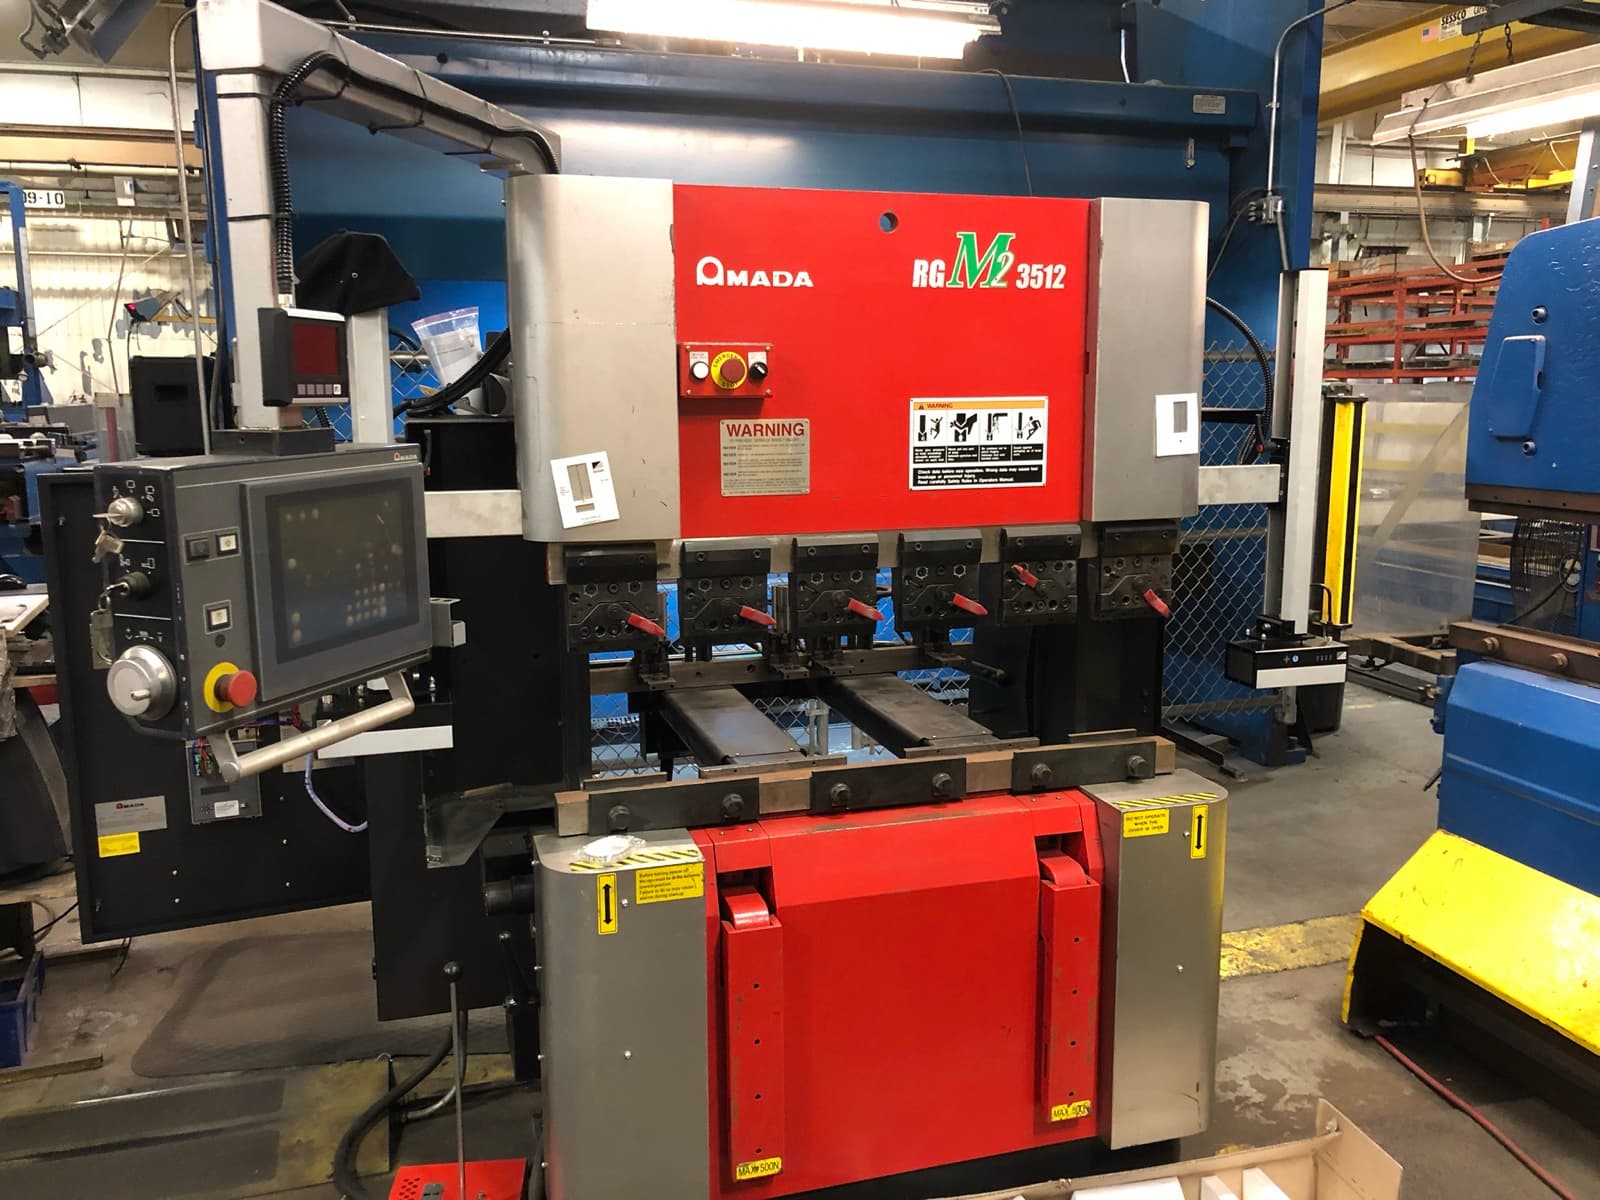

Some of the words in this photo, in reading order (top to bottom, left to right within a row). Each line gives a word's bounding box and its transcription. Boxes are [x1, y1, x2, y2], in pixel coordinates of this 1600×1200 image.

[1441, 9, 1466, 25] SESSCO
[696, 256, 814, 287] AMADA
[912, 259, 946, 288] RG
[1016, 263, 1066, 289] 3512
[726, 423, 805, 437] WARNING
